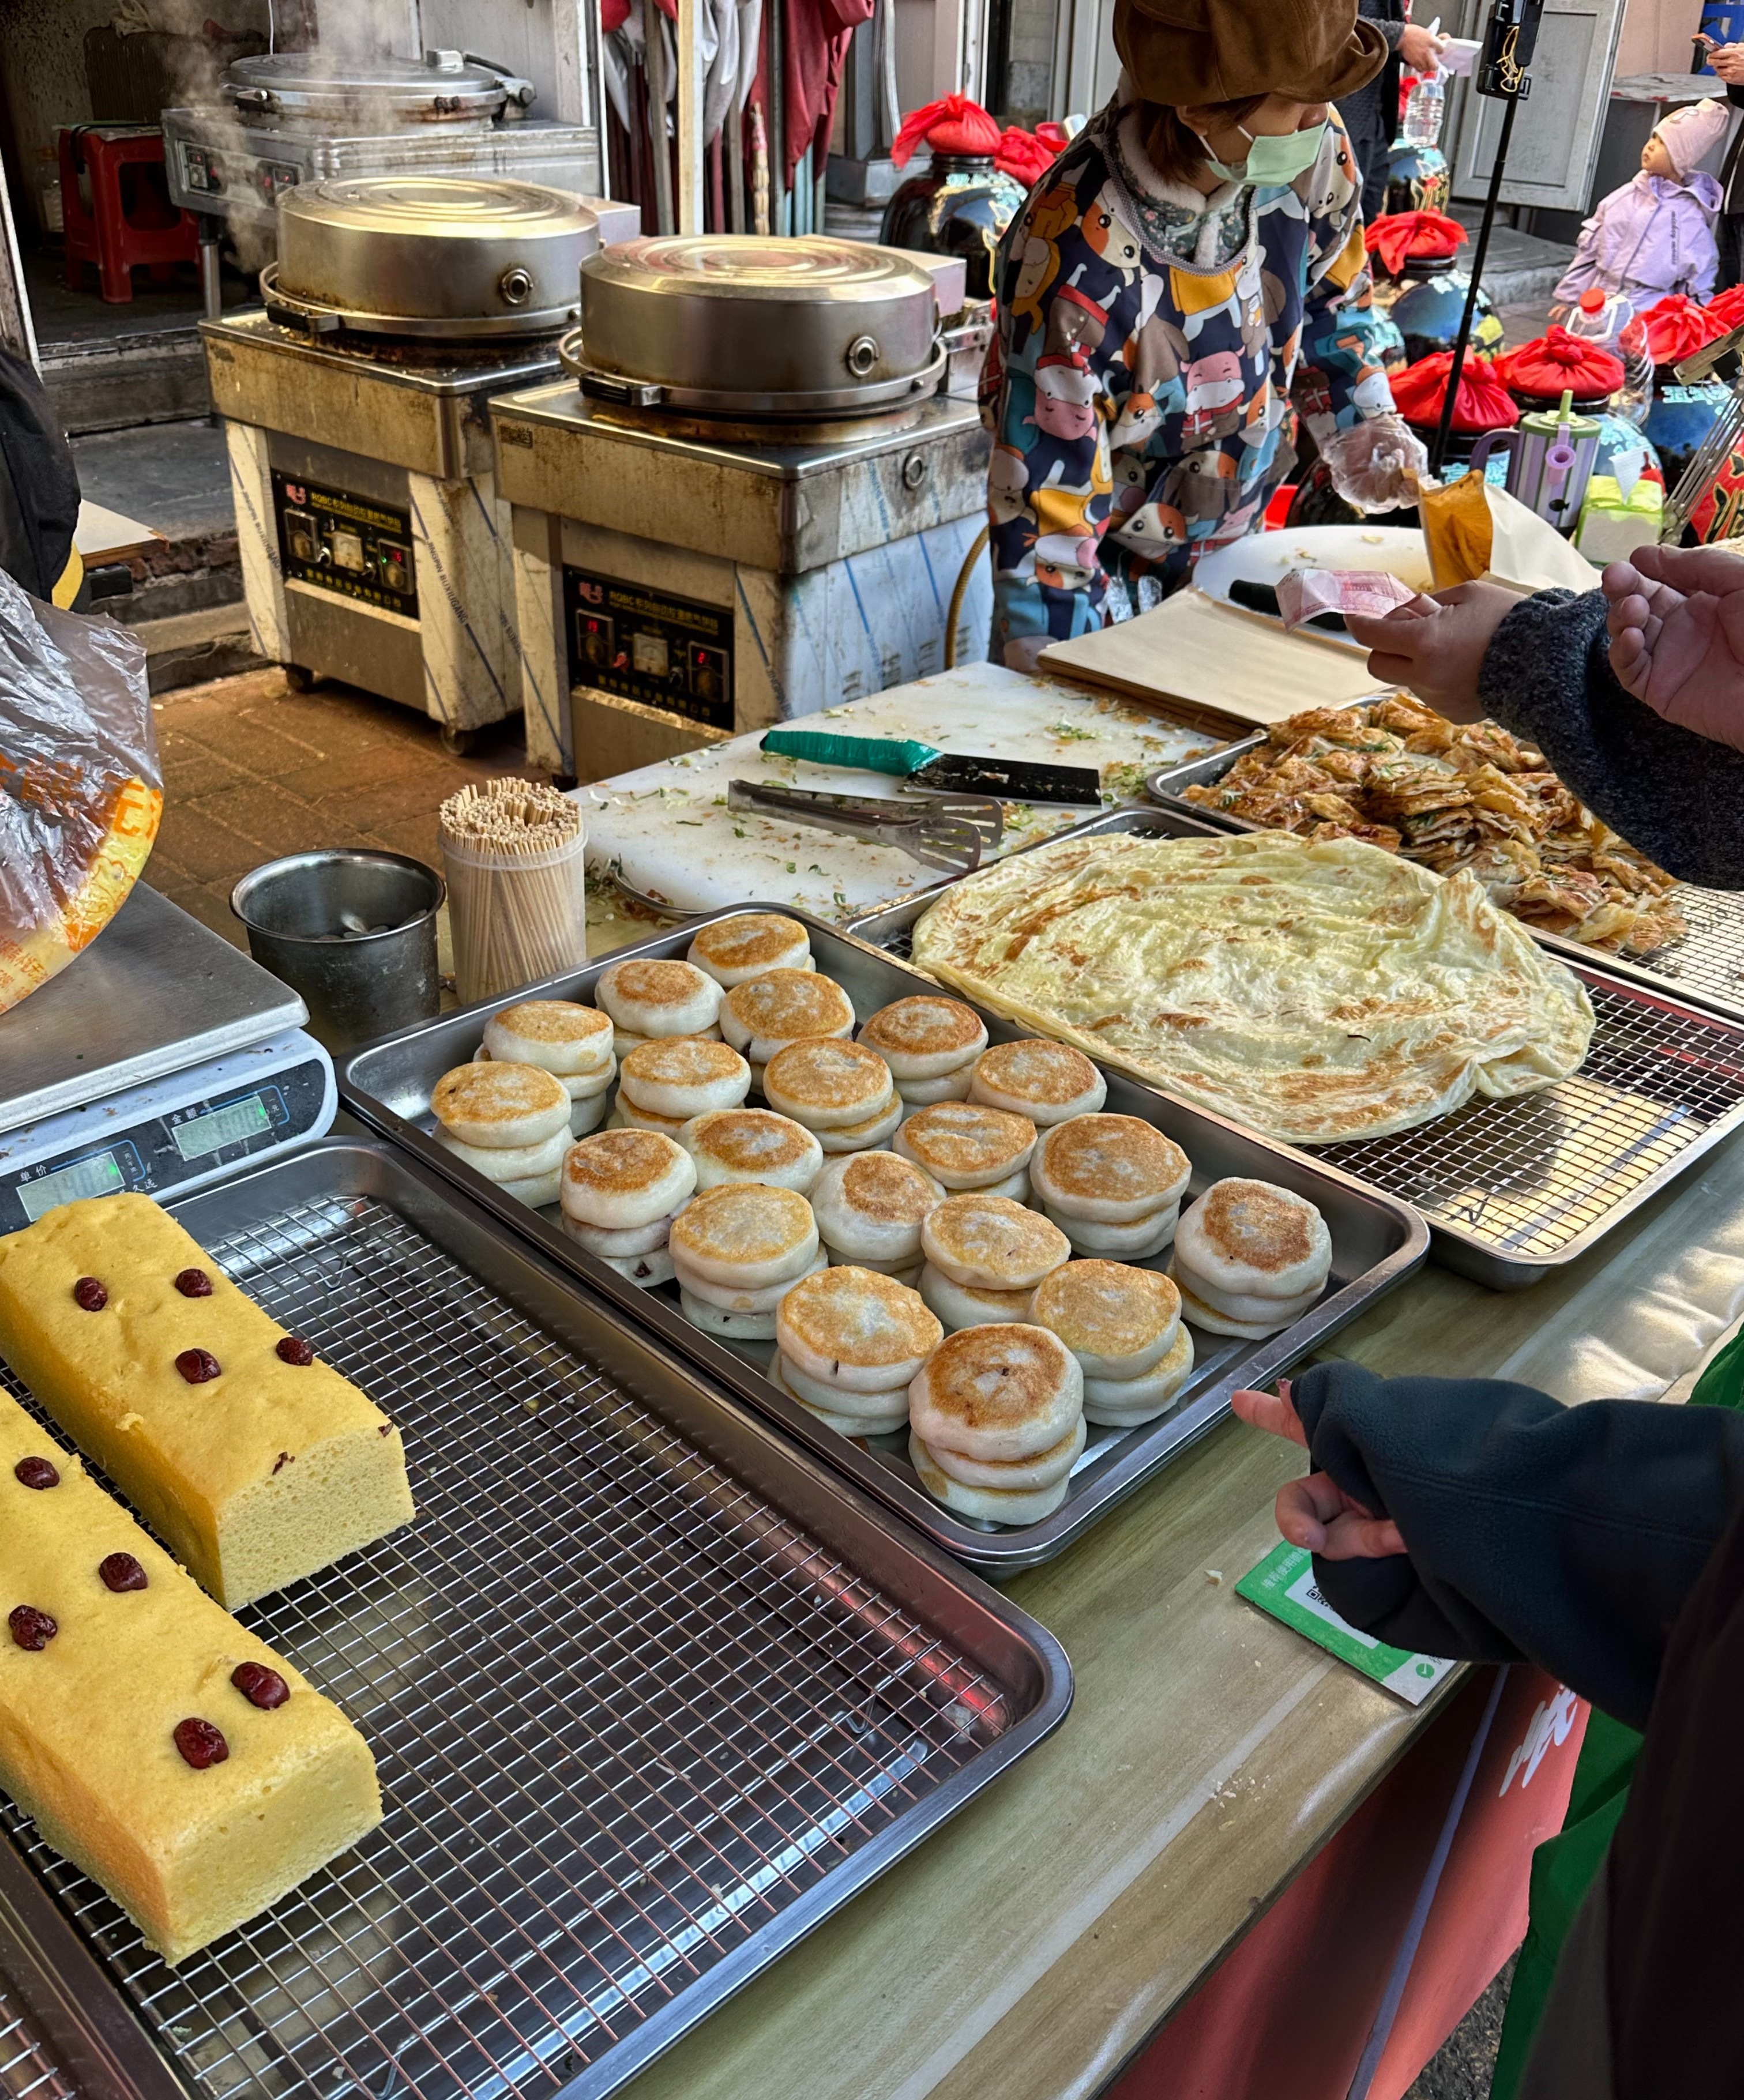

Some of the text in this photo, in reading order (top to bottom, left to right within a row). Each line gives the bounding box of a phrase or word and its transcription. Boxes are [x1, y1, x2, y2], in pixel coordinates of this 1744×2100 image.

[427, 540, 444, 573] JINGPIN
[439, 572, 468, 624] BUXIUGANG
[171, 1107, 198, 1125] 金额
[20, 1164, 47, 1183] 单价
